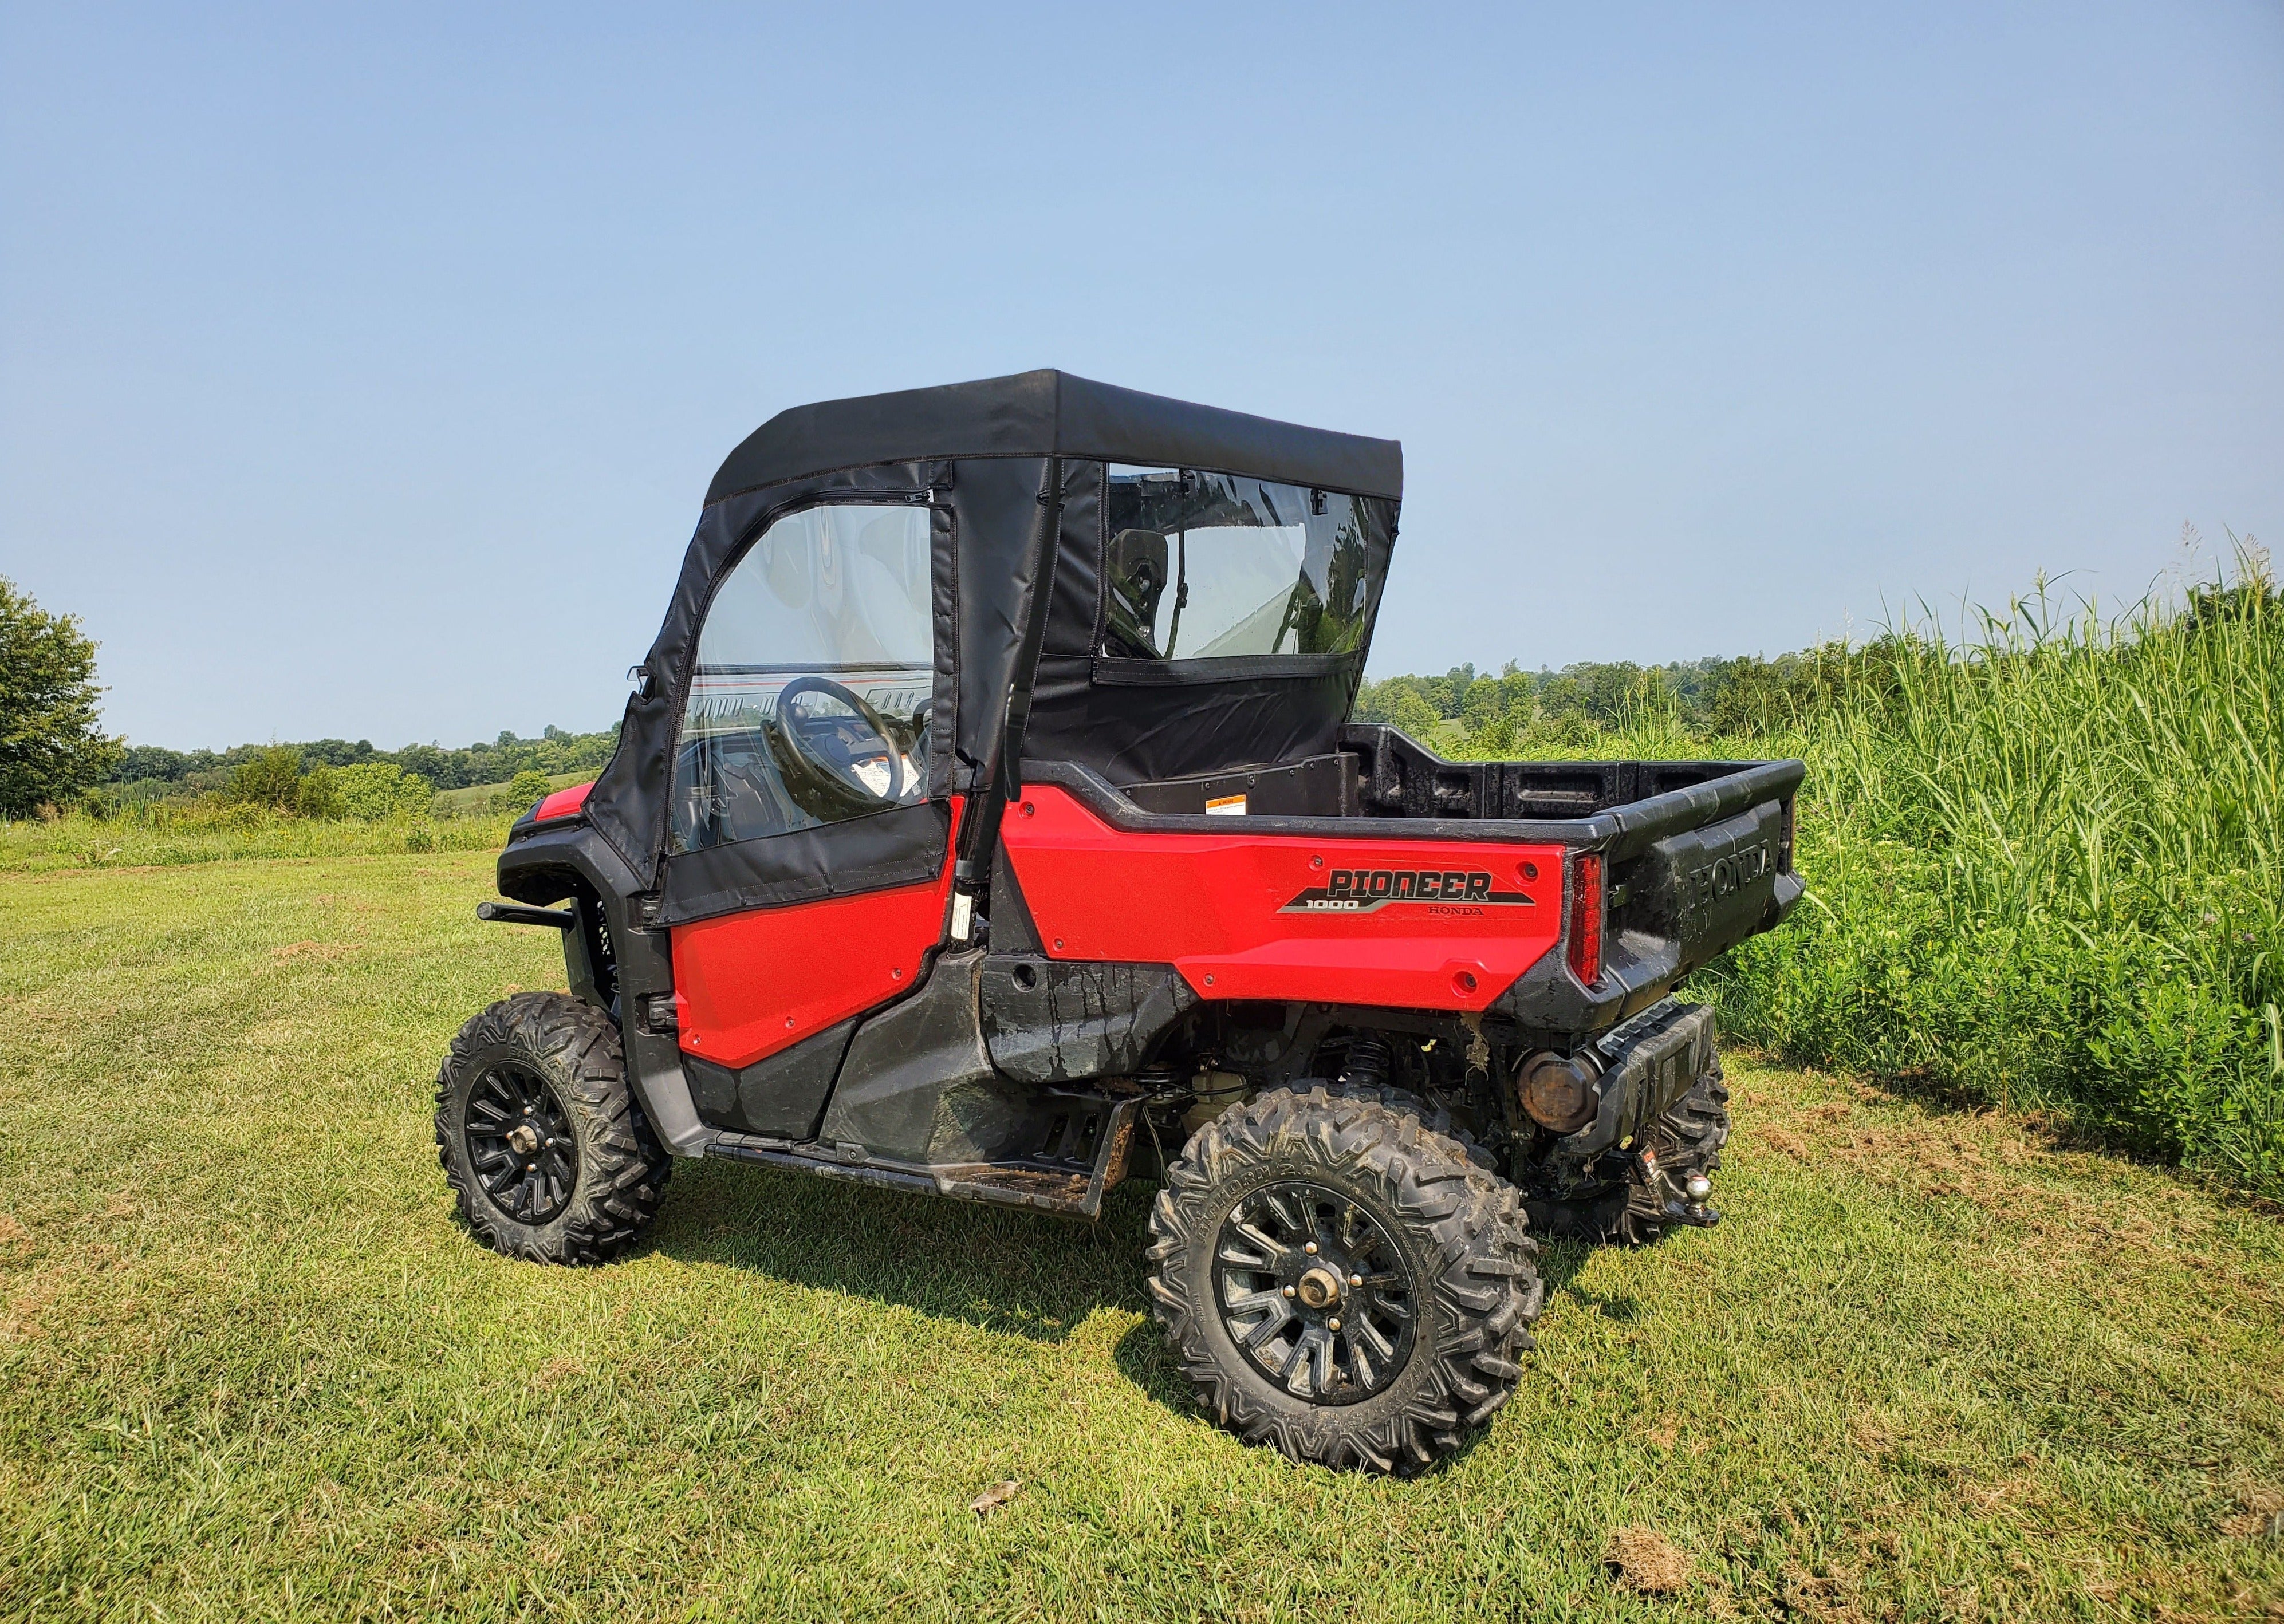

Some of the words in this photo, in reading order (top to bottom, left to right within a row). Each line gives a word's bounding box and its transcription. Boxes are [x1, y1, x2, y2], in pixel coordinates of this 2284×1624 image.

[1688, 838, 1775, 909] HONDA
[1326, 869, 1491, 901] PIONEER
[1306, 900, 1359, 909] 1000
[1427, 906, 1484, 916] HONDA
